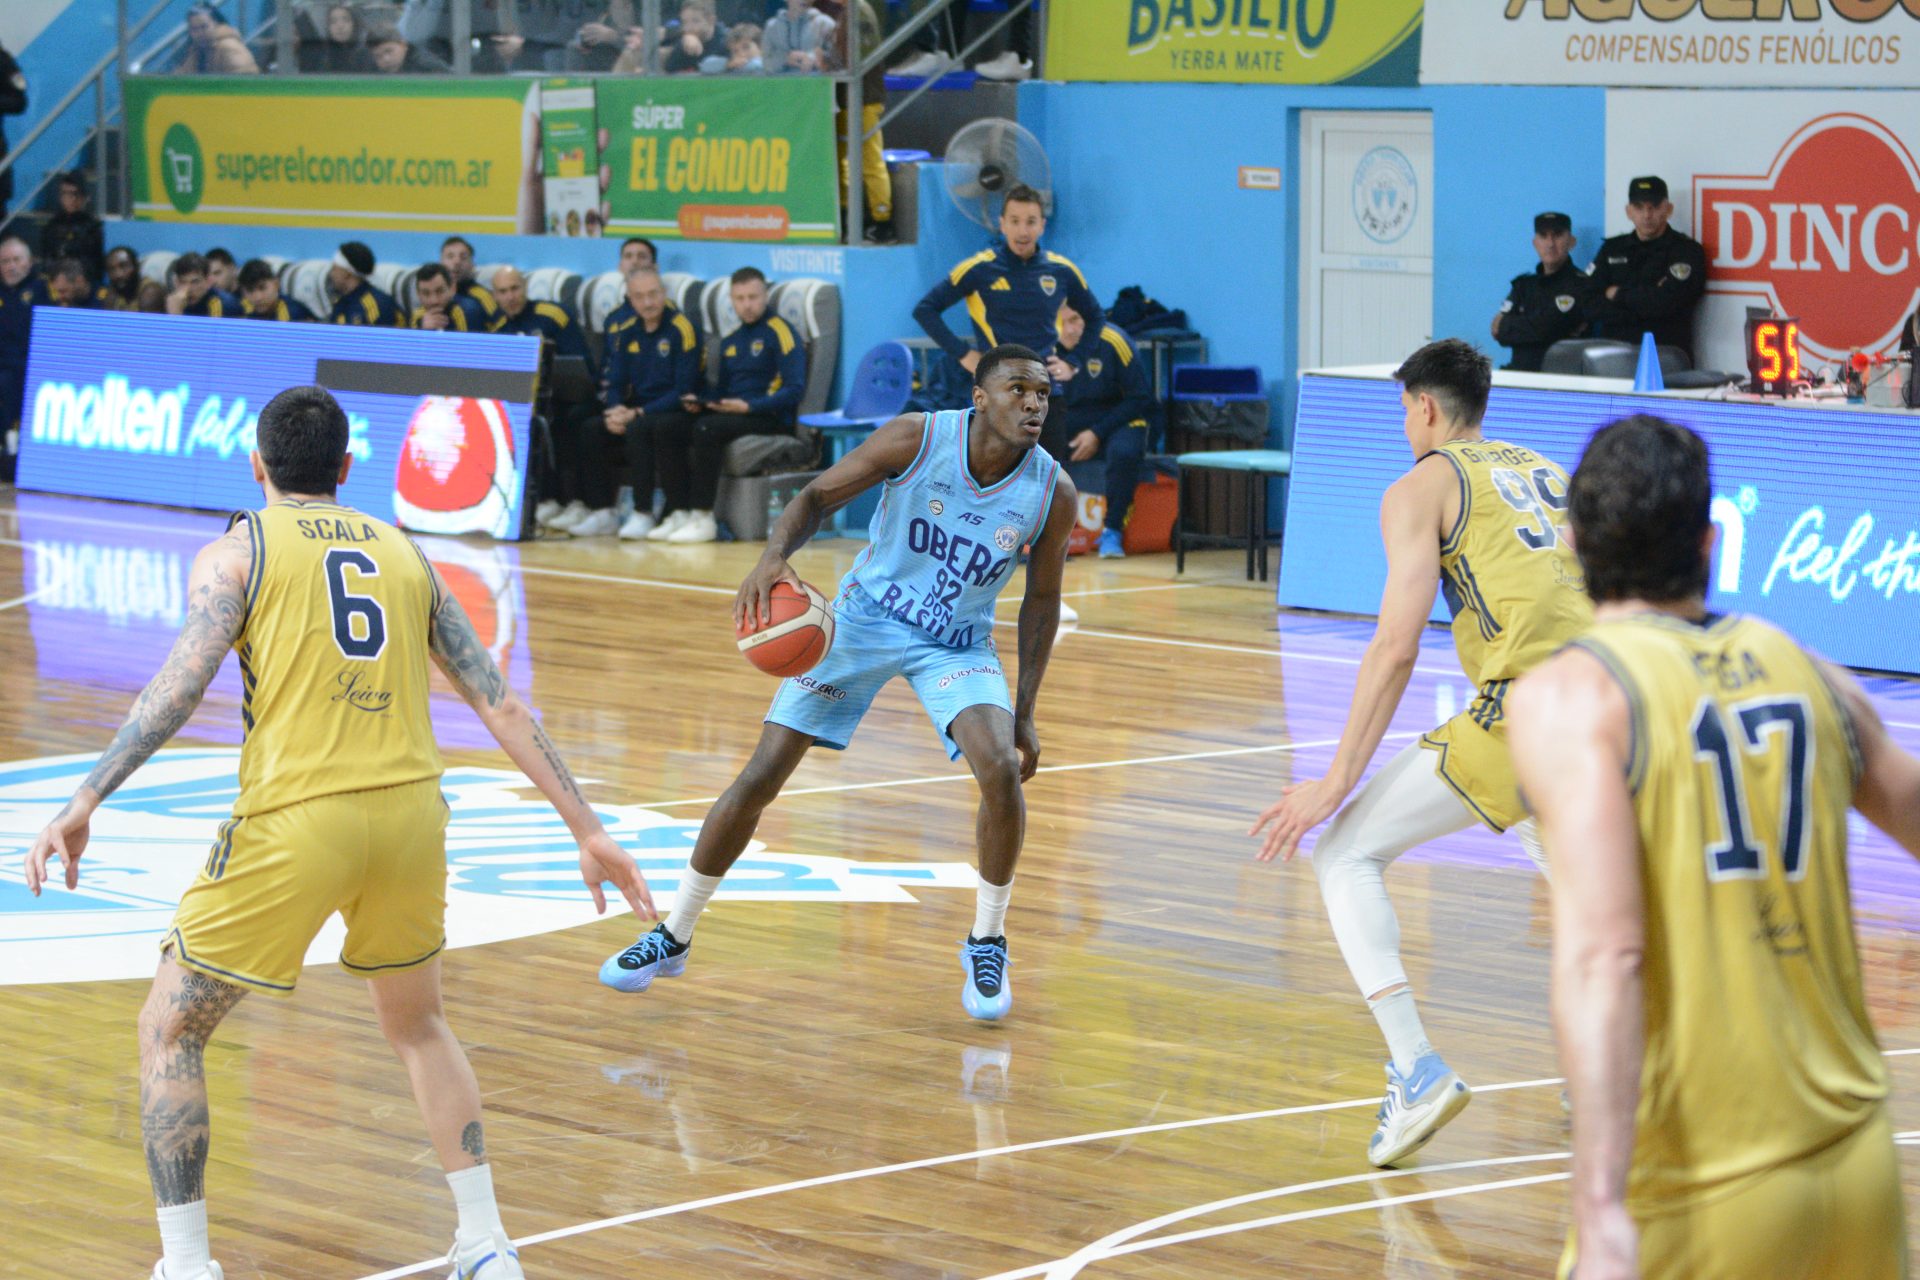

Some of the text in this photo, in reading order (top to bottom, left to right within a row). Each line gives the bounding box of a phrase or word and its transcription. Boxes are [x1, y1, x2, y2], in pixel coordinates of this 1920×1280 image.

[1170, 49, 1285, 72] YERBA MATE
[1565, 28, 1901, 65] COMPENSADOS FENÓLICOS
[631, 98, 686, 130] SÚPER
[215, 145, 493, 191] superelcondor.com.ar
[629, 123, 790, 194] EL CÓNDOR
[769, 248, 844, 275] VISITANTE
[1711, 201, 1920, 277] DINC
[1755, 321, 1799, 382] 55
[31, 373, 184, 457] molten
[297, 518, 380, 542] SCALA
[908, 517, 1013, 588] OBERA
[1762, 505, 1875, 602] feel
[1862, 530, 1920, 602] th
[323, 546, 389, 662] 6
[921, 592, 953, 626] DON
[931, 567, 963, 613] 92
[331, 671, 393, 712] Leiva
[1689, 692, 1815, 883] 17
